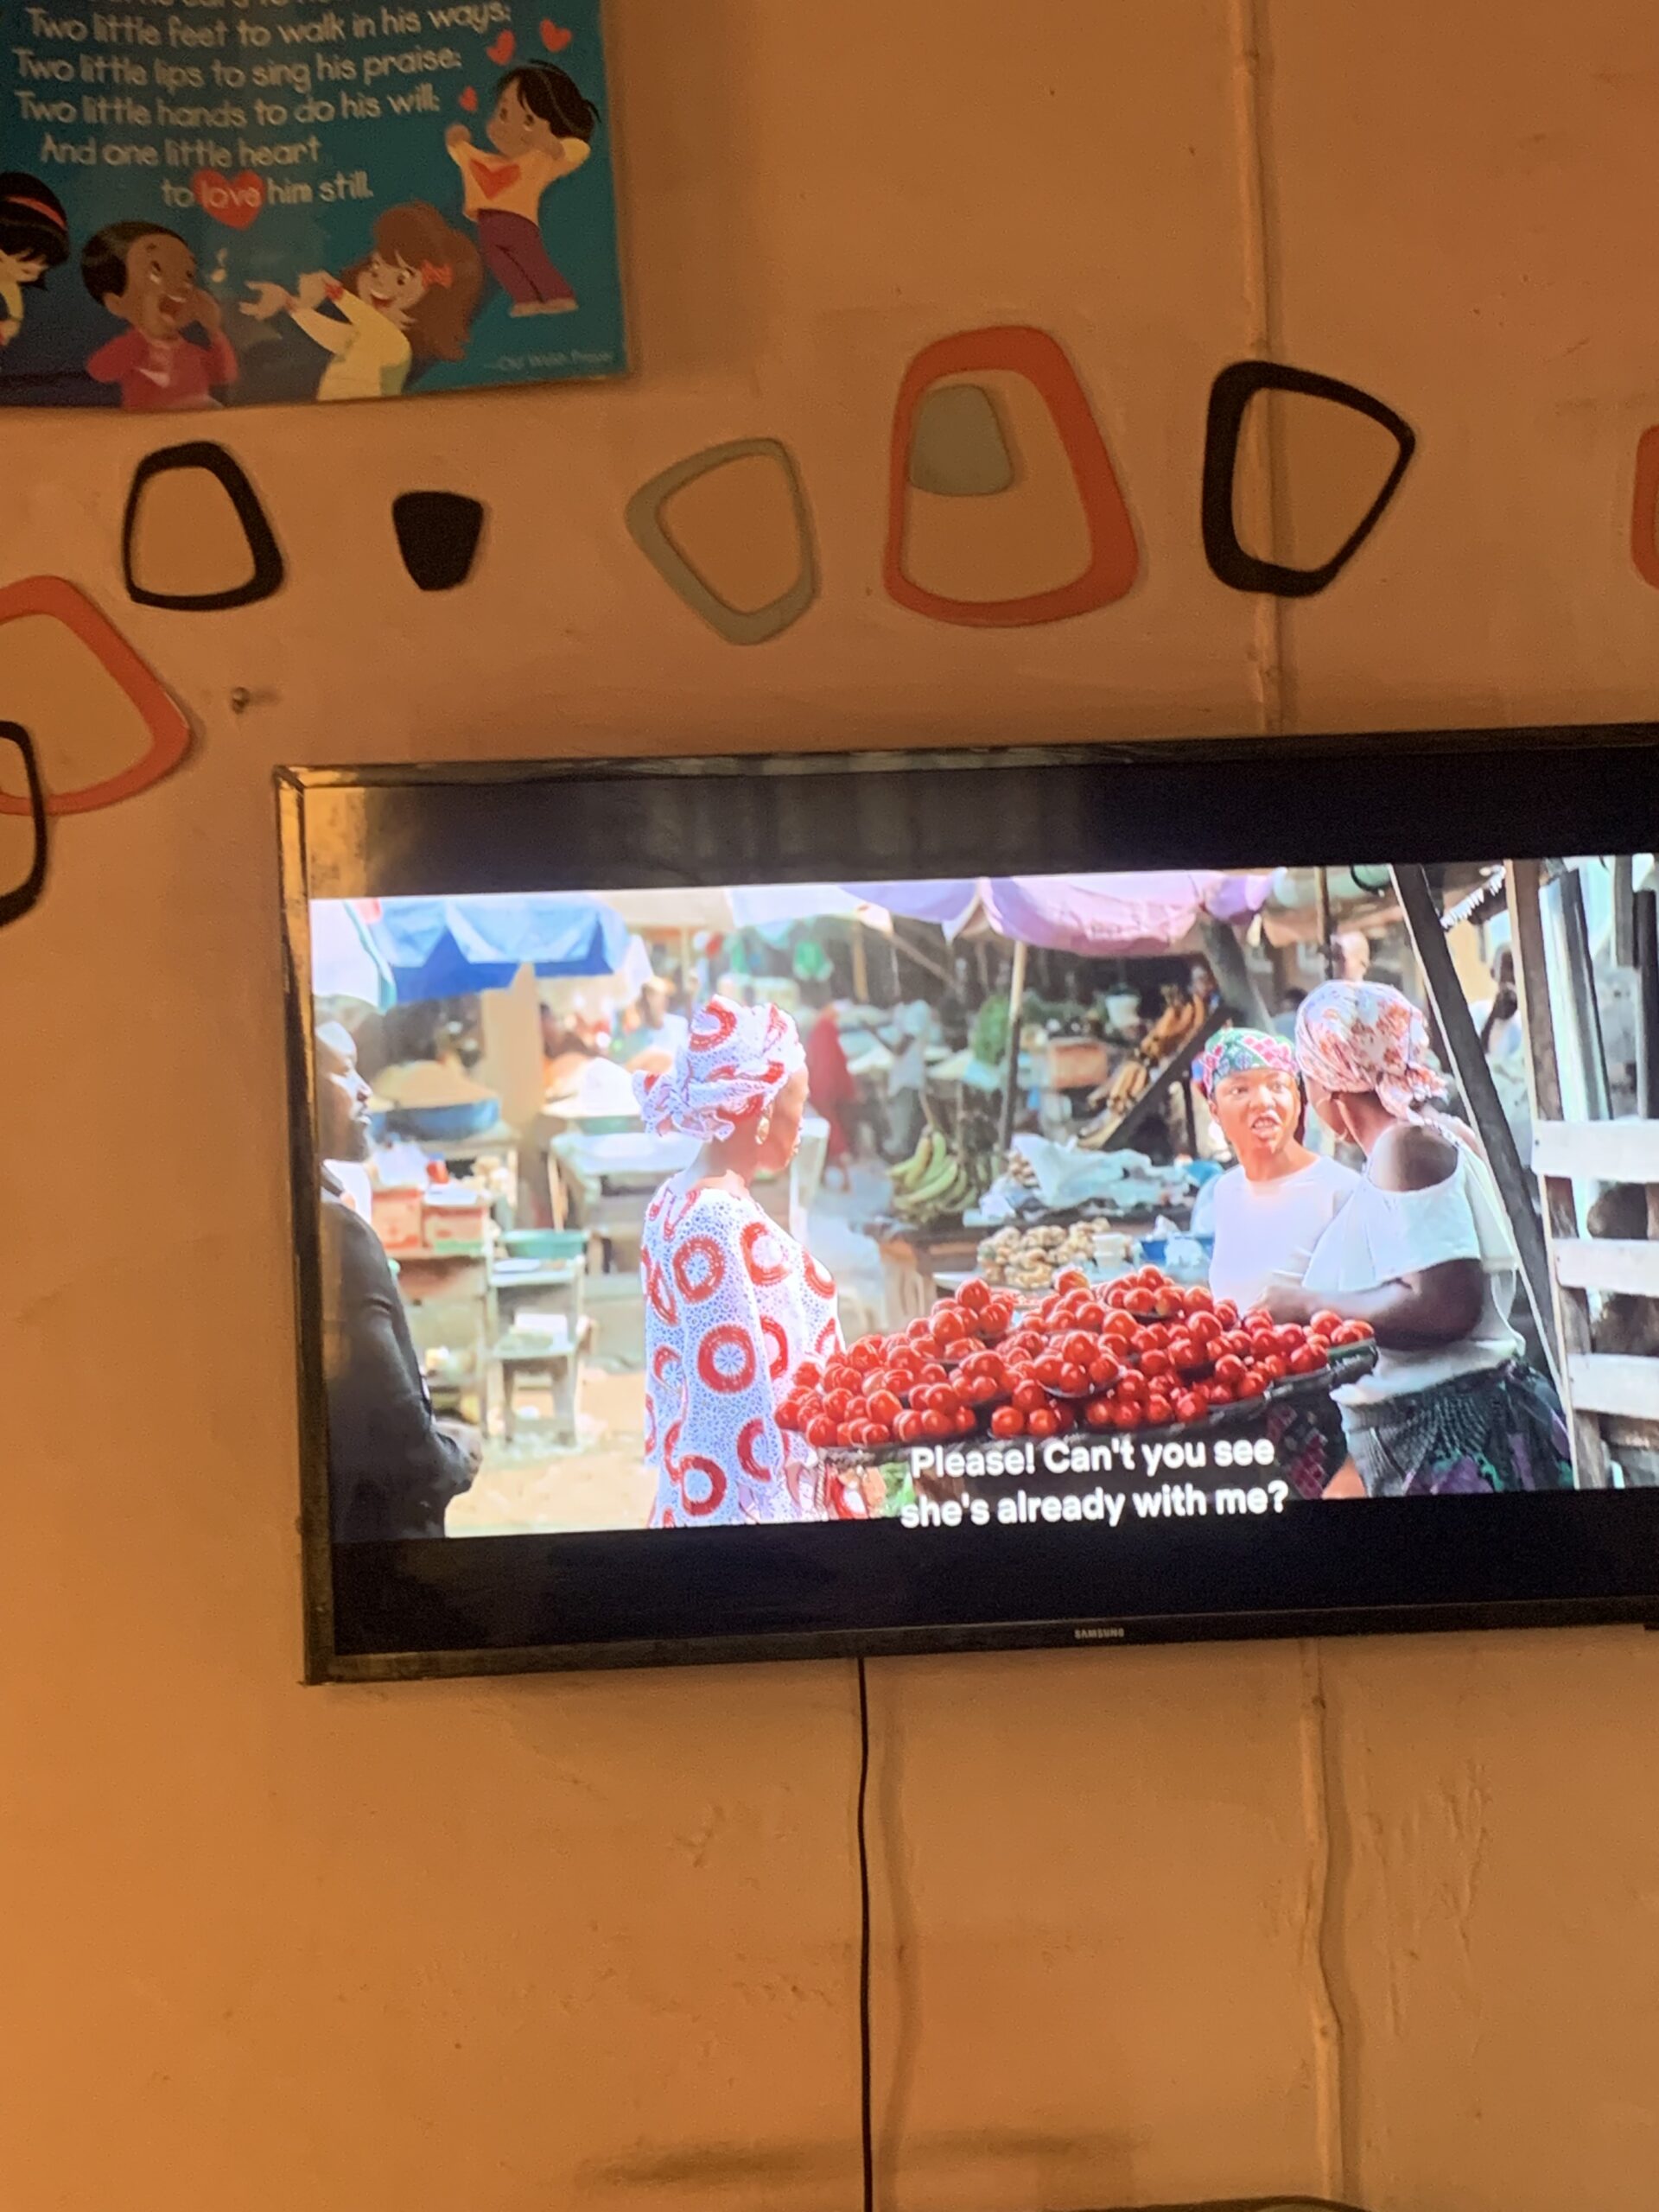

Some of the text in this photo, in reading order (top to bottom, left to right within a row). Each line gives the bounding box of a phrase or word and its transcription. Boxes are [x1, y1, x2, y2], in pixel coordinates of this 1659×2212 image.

[25, 7, 88, 41] Two
[92, 12, 162, 46] little
[168, 15, 228, 48] feet
[236, 18, 271, 47] to
[276, 10, 346, 43] walk
[352, 12, 377, 38] in
[380, 6, 422, 35] his
[12, 47, 74, 81] Two
[79, 53, 149, 86] little
[154, 56, 205, 96] lips
[211, 58, 246, 88] to
[251, 58, 312, 93] sing
[315, 51, 357, 81] his
[14, 90, 77, 124] Two
[82, 95, 151, 126] little
[156, 95, 247, 128] hands
[253, 97, 289, 126] to
[294, 94, 335, 123] do
[340, 90, 381, 119] his
[40, 132, 321, 168] And one little heart
[161, 177, 195, 207] to
[200, 179, 264, 209] love
[265, 176, 314, 206] him
[910, 1437, 1275, 1478] Please! Can't you see
[899, 1478, 1290, 1529] she's already with me?
[1073, 1627, 1124, 1639] SAMSUNG
